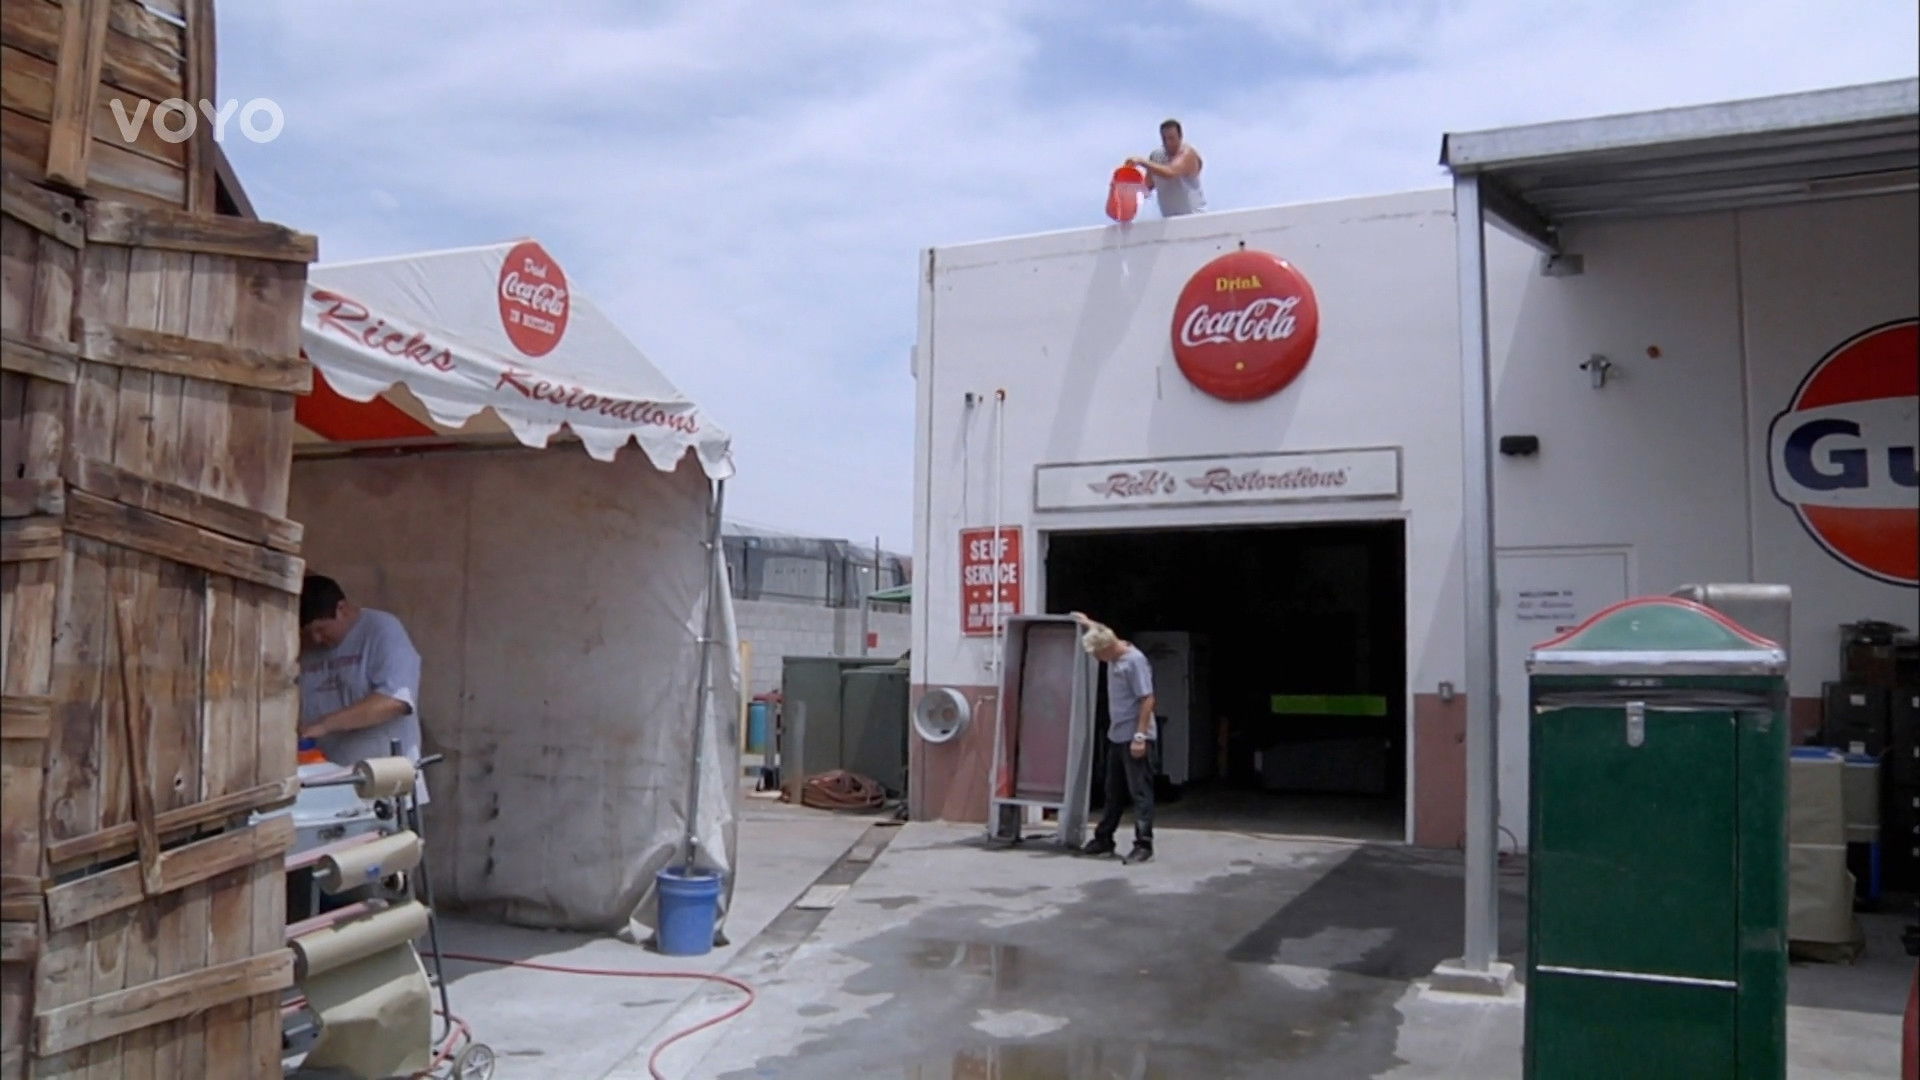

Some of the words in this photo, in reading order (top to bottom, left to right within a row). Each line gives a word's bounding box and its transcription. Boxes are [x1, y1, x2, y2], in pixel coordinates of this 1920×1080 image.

[1215, 275, 1262, 292] Drink
[311, 289, 454, 373] Ricks
[1086, 469, 1177, 499] Rick's
[1185, 467, 1347, 496] Restorations
[965, 562, 1017, 586] SERVCE
